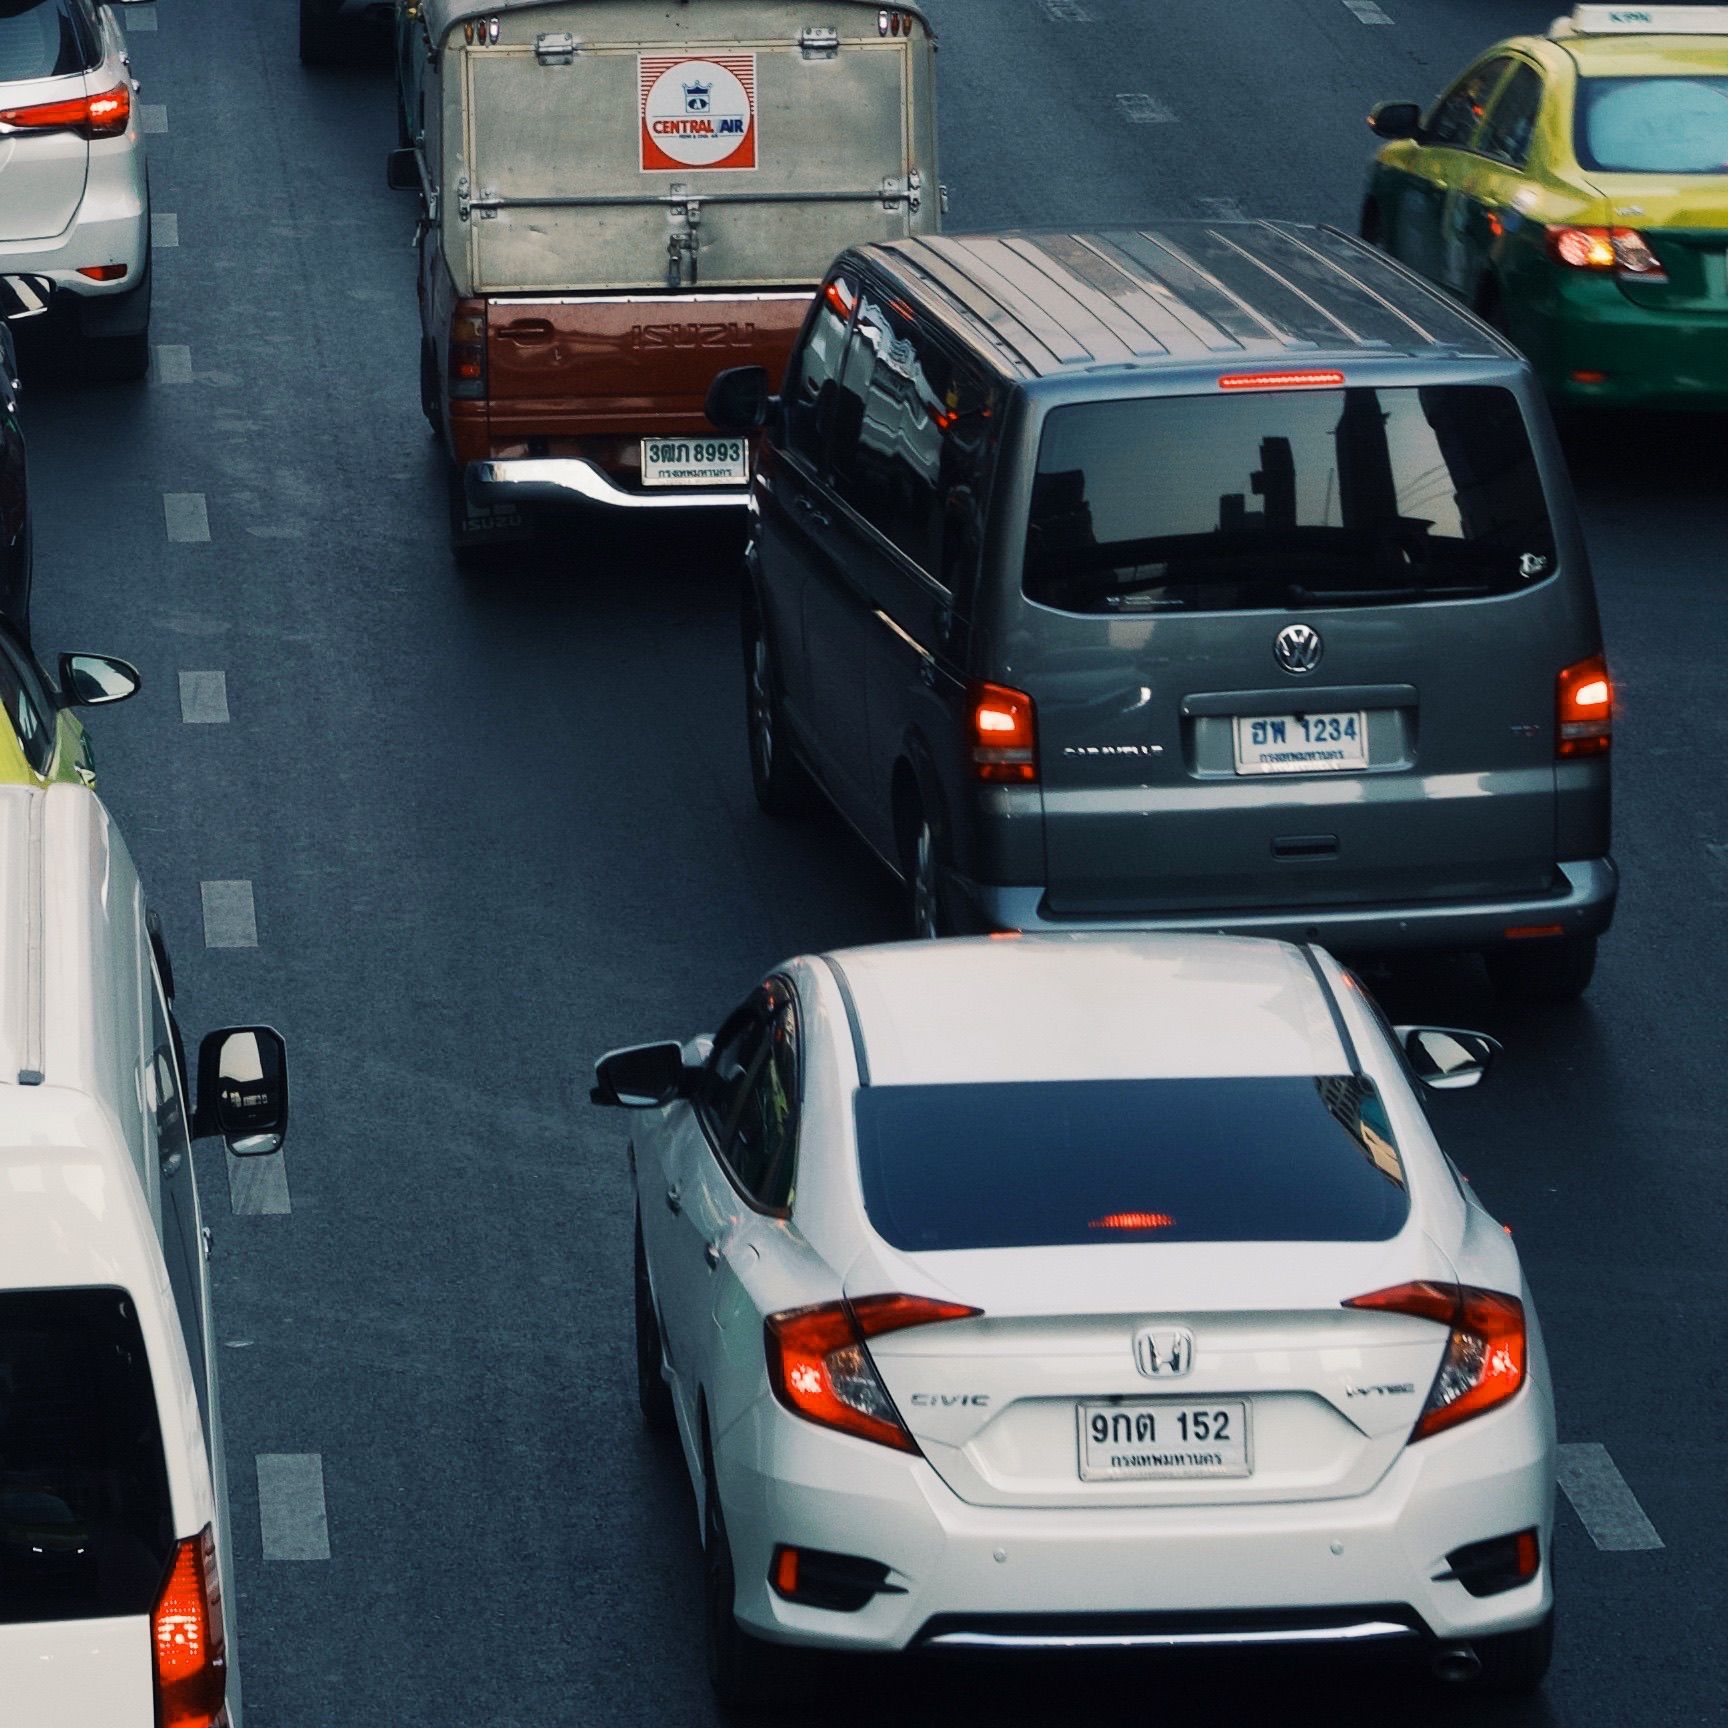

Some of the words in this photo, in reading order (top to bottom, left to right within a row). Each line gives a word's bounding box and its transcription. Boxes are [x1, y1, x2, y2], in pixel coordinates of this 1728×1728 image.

[653, 119, 714, 134] CENTRAL
[719, 119, 744, 134] AIR
[631, 322, 755, 349] ISUZU
[693, 443, 741, 462] 8993
[1300, 717, 1358, 742] 1234
[910, 1393, 990, 1406] CIVIC
[1091, 1412, 1157, 1445] 9กต
[1177, 1411, 1231, 1441] 152
